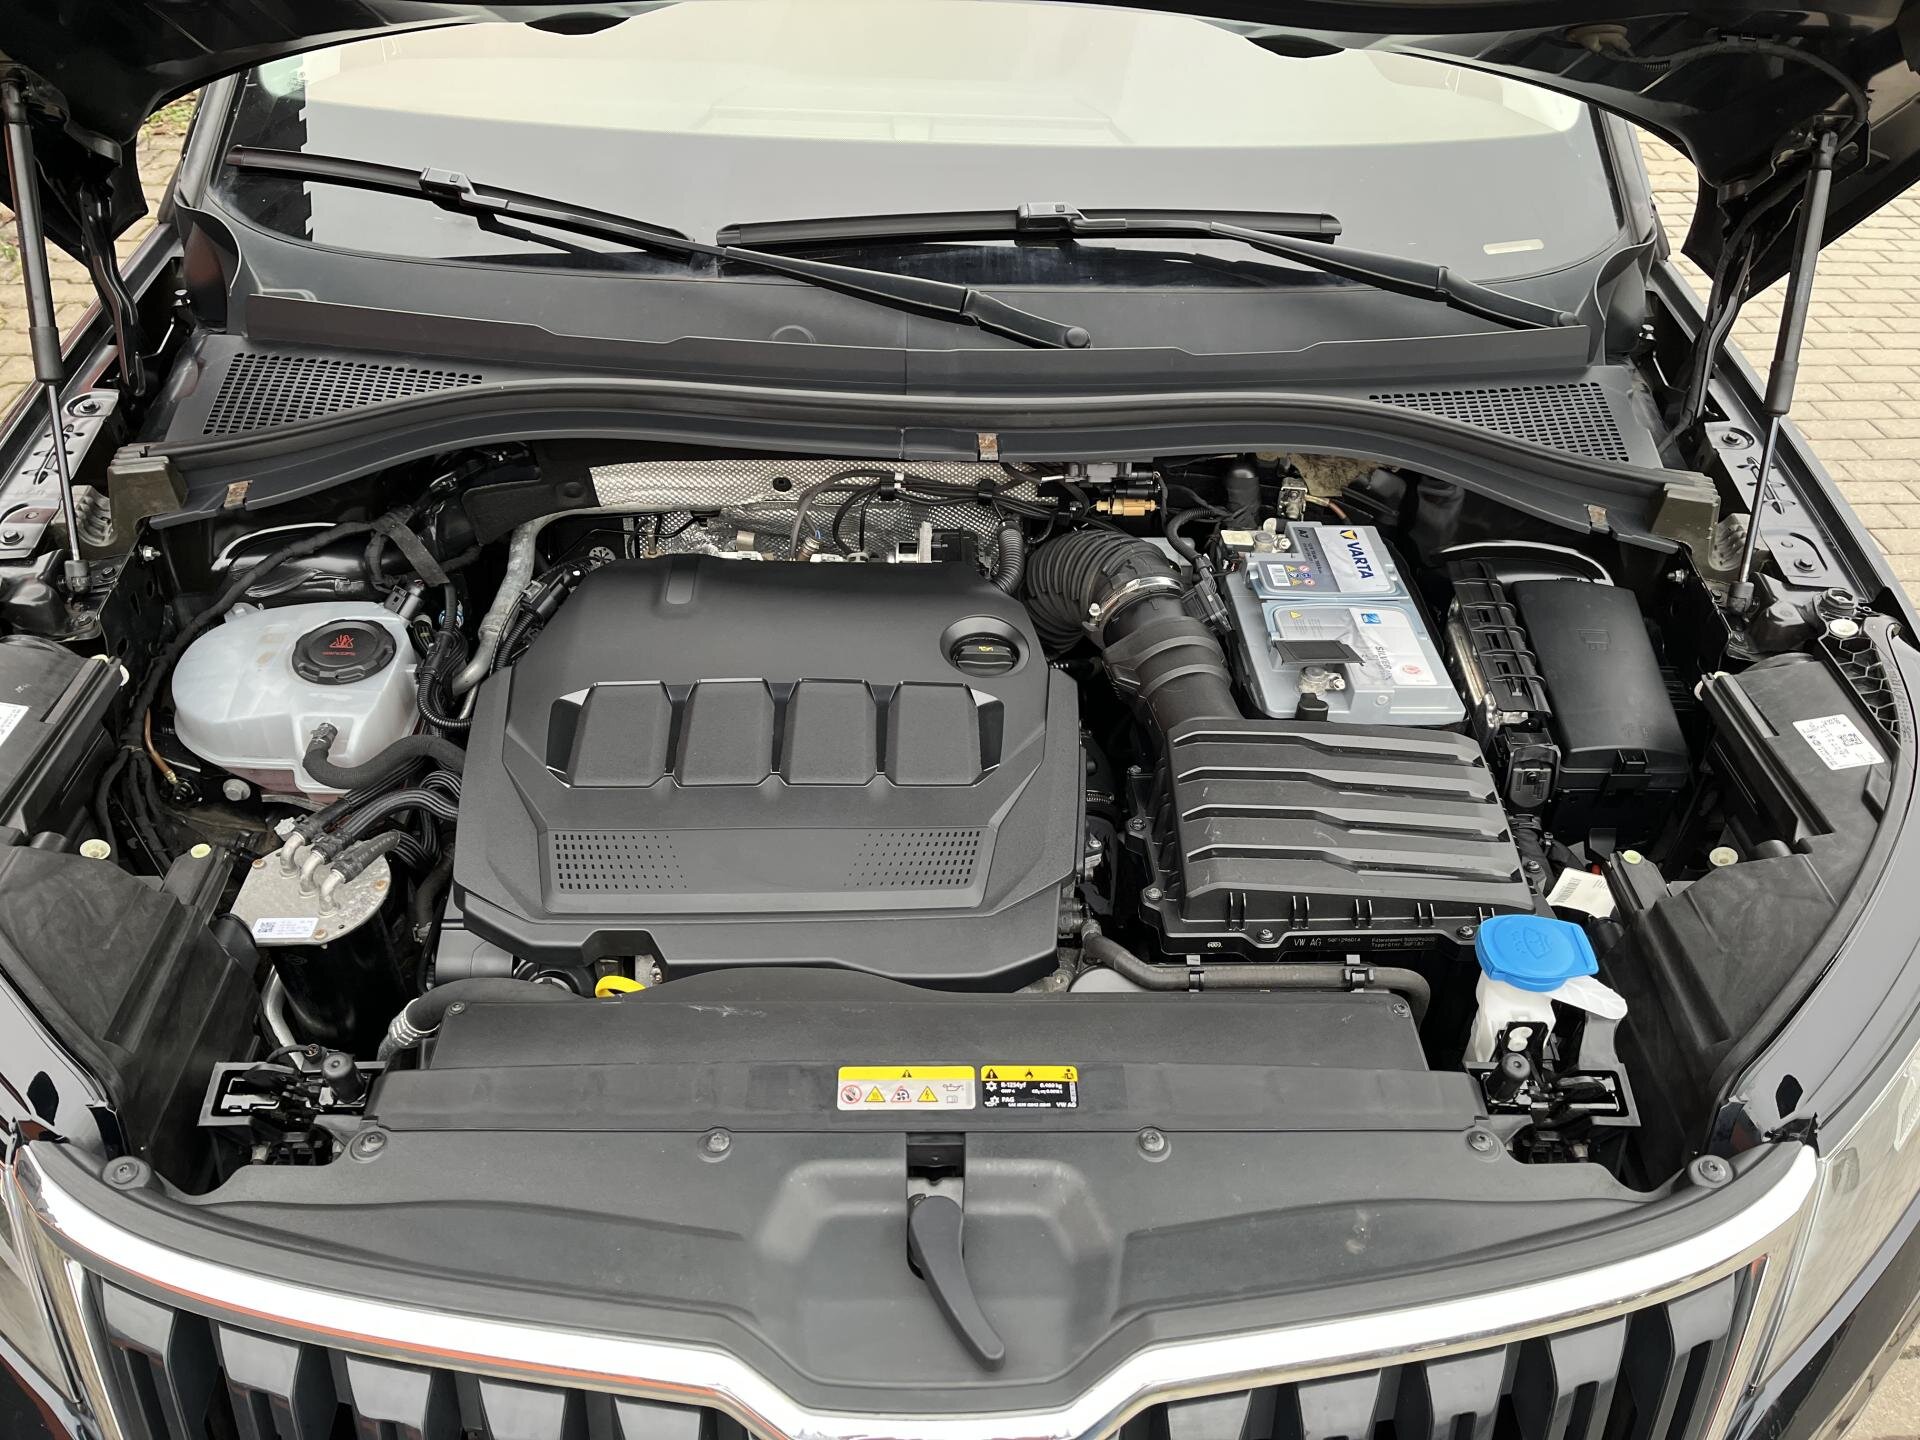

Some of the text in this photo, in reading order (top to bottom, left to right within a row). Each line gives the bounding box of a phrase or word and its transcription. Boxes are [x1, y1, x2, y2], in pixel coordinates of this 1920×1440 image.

[1347, 542, 1374, 579] VARTA
[1294, 937, 1321, 946] VW AG
